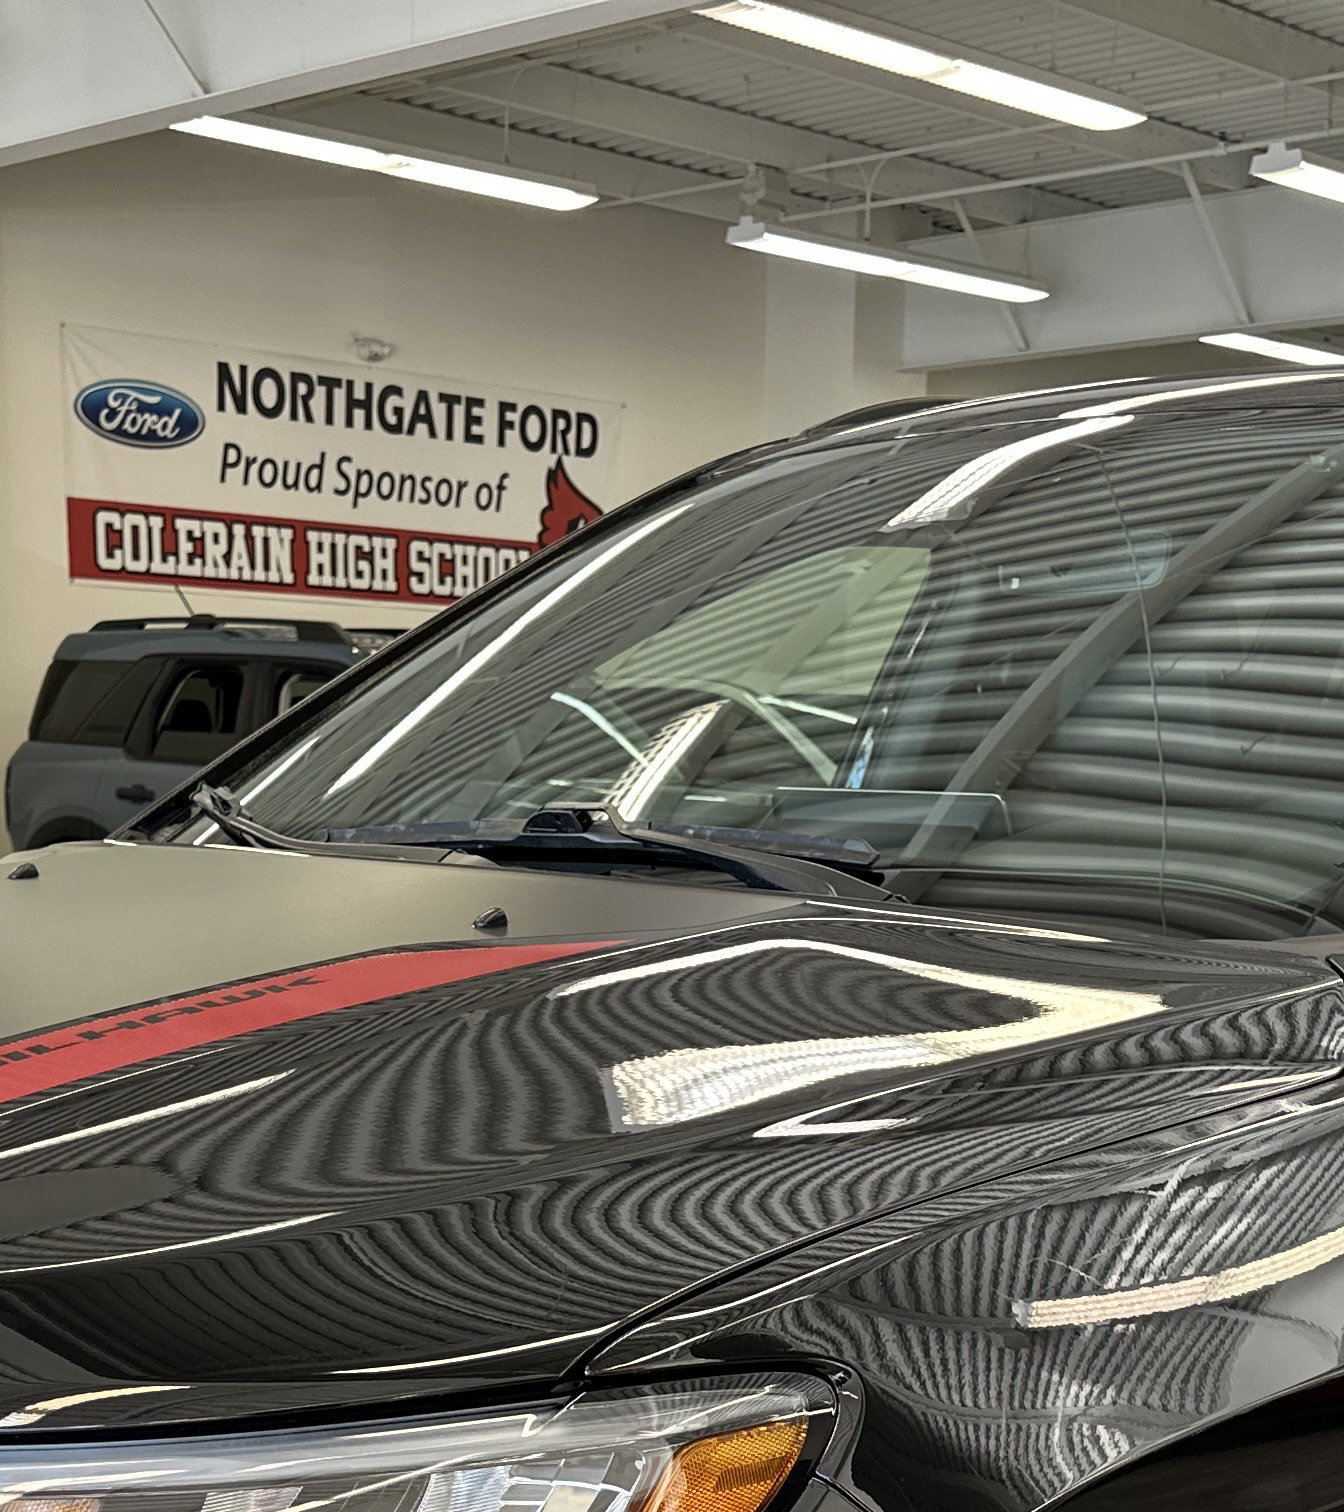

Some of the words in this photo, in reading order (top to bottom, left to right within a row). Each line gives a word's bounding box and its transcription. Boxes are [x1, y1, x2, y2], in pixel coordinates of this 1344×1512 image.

[98, 387, 183, 439] Ford
[215, 360, 486, 446] NORTHGATE
[496, 401, 600, 459] FORD
[218, 441, 327, 495] Proud
[333, 453, 470, 510] Sponsor
[474, 472, 509, 514] of
[92, 507, 297, 587] COLERAIN
[306, 528, 399, 595] HIGH
